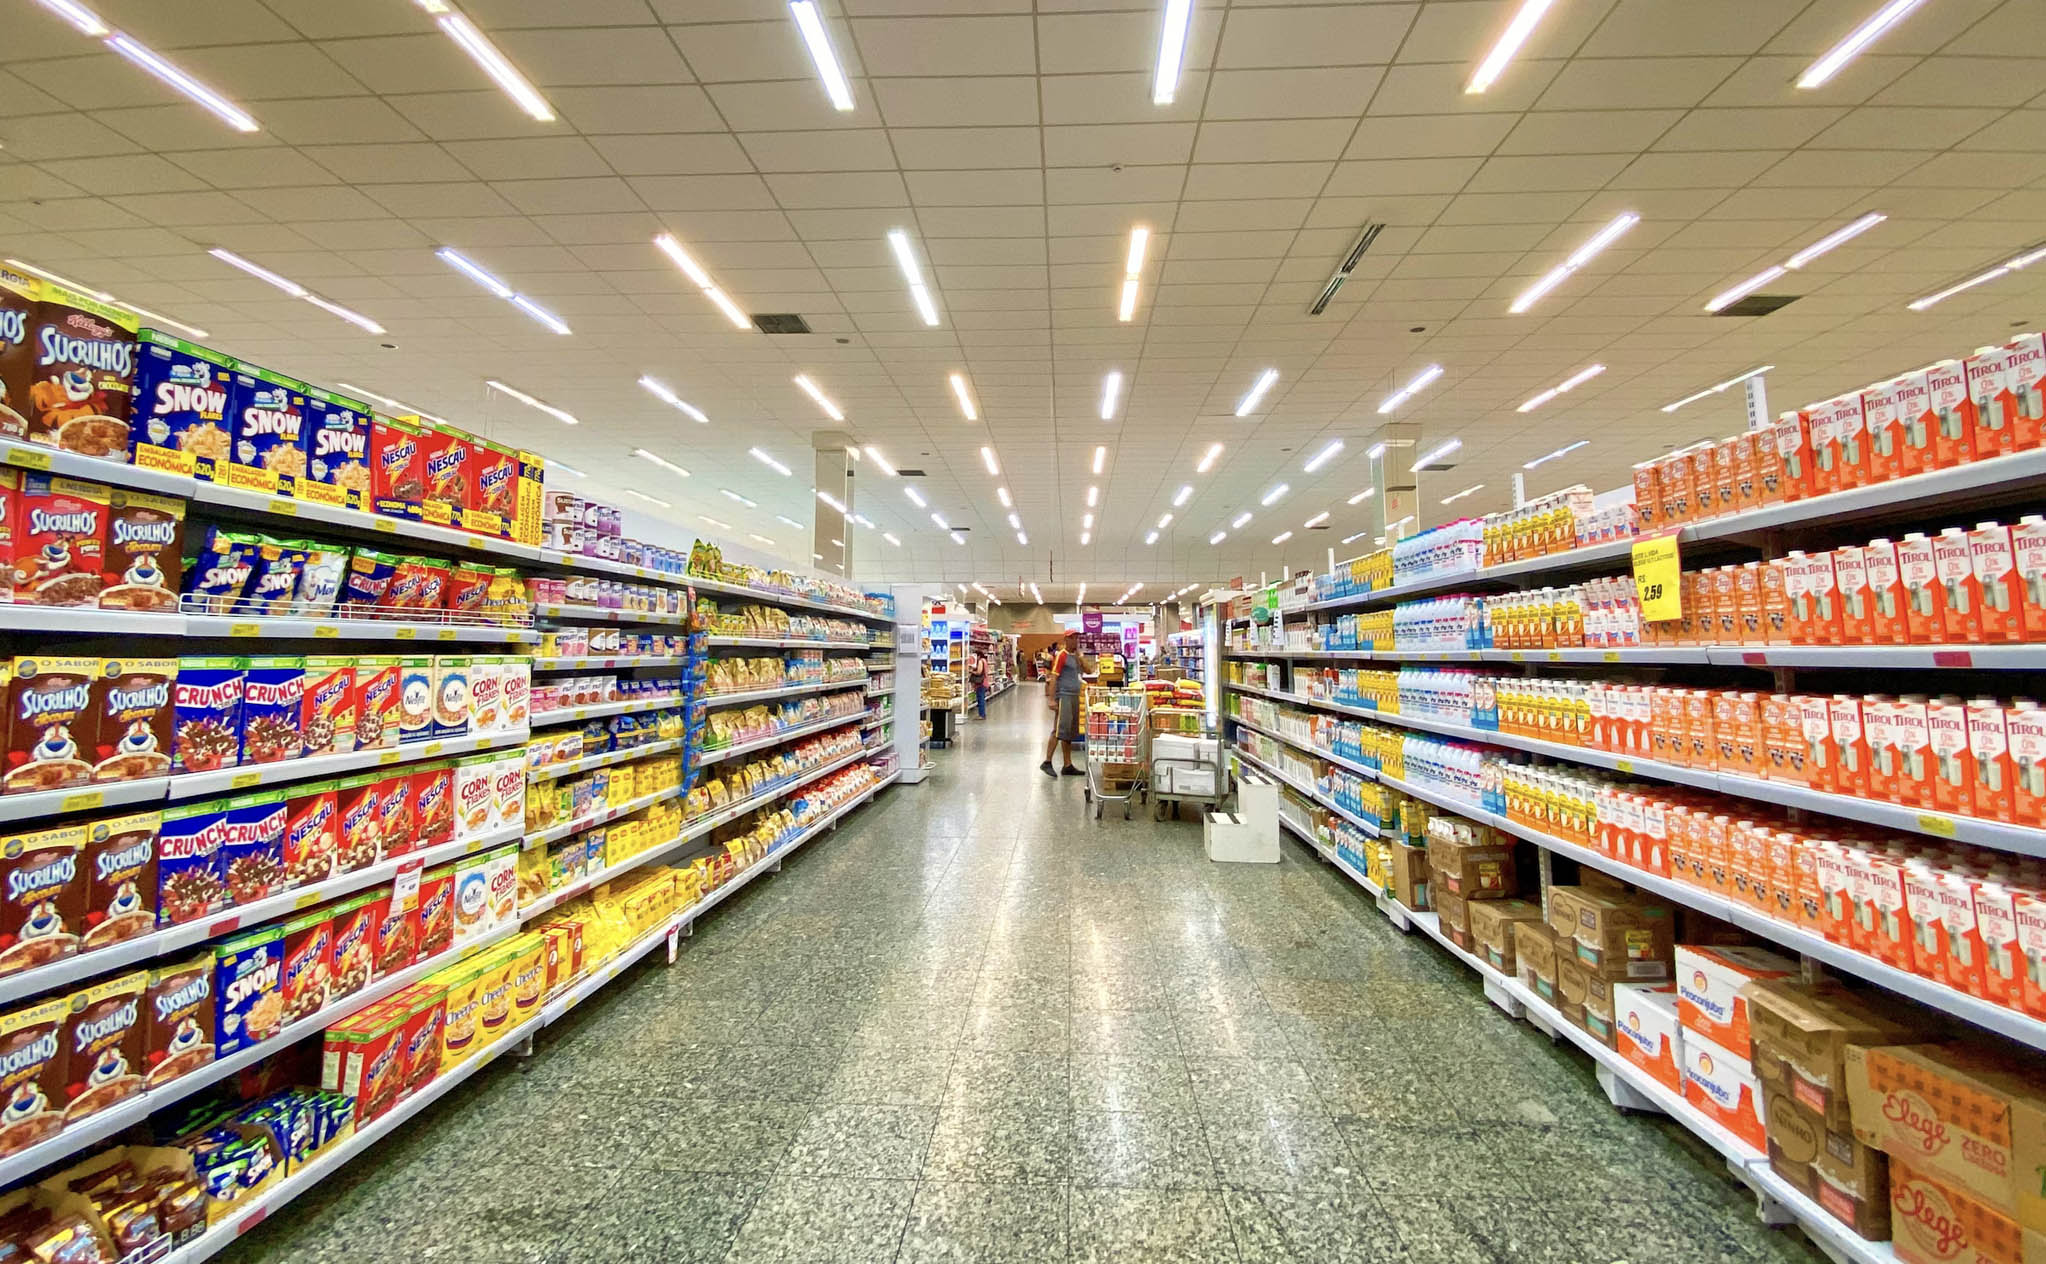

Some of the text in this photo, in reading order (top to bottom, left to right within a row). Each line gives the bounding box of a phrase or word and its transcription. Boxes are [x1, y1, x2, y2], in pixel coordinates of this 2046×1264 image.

[40, 327, 133, 377] SUCRILHOS
[2006, 349, 2043, 368] TIROL
[1969, 361, 2005, 379] TIROL
[1896, 385, 1928, 402] TIROL
[1930, 375, 1963, 391] TIROL
[154, 381, 228, 414] SNOW
[1866, 394, 1894, 411] TIROL
[242, 408, 302, 437] SNOW
[1835, 407, 1860, 421] TIROL
[315, 429, 366, 455] SNOW
[381, 441, 417, 467] NESCAU
[138, 454, 193, 475] ECONÔMICA
[427, 448, 466, 476] NESCAU
[230, 474, 276, 490] ECONÔMICA
[480, 462, 513, 490] NESCAU
[31, 508, 97, 535] SUCRILHOS
[114, 518, 175, 544] SUCRILHOS
[1936, 547, 1969, 560] TIROL
[1972, 542, 2009, 556] TIROL
[2015, 536, 2046, 550] TIRO
[1837, 559, 1863, 571] TIROL
[1867, 555, 1895, 567] TIROL
[1900, 551, 1933, 565] TIROL
[200, 567, 252, 588] SNOW
[350, 573, 388, 594] CRUNC
[176, 679, 242, 706] CRUNCH
[246, 677, 304, 703] CRUNCH
[315, 675, 350, 708] NESCAU
[365, 672, 397, 704] NESCAU
[473, 676, 498, 696] CORN
[505, 676, 526, 694] CORN
[22, 684, 90, 719] SUCRILHOS
[109, 682, 169, 716] SUCRILHOS
[1832, 711, 1858, 722] TIROL
[1865, 712, 1893, 725] TIROL
[1893, 714, 1926, 728] TIROL
[1929, 717, 1963, 731] TIROL
[1969, 720, 2004, 733] TIROL
[2008, 722, 2046, 737] TIROL
[461, 776, 488, 800] CORN
[496, 769, 521, 792] CORN
[418, 776, 449, 812] NESCAU
[226, 811, 287, 842] CRUNCH
[290, 801, 333, 848] NESCAU
[343, 793, 379, 836] NESCAU
[161, 821, 226, 857] CRUNCH
[98, 837, 153, 881] SUCRILHOS
[9, 854, 77, 900] SUCRILHOS
[491, 866, 515, 891] CORN
[1845, 866, 1871, 881] TIROL
[1872, 874, 1899, 890] TIROL
[421, 884, 450, 921] NESCAU
[1906, 883, 1935, 900] TIROL
[1939, 892, 1971, 911] TIROL
[1976, 901, 2014, 921] TIROL
[2017, 912, 2046, 932] TIRO
[335, 914, 370, 963] NESCAU
[287, 930, 330, 985] NESCAU
[156, 973, 210, 1022] SUCRILHOS
[224, 961, 281, 1012] SNOW
[76, 999, 138, 1052] SUCRILHOS
[408, 1008, 442, 1055] NESCAU
[0, 1029, 58, 1077] UCRILHOS
[367, 1030, 403, 1083] NESCAU
[1961, 1136, 2006, 1166] ZERO
